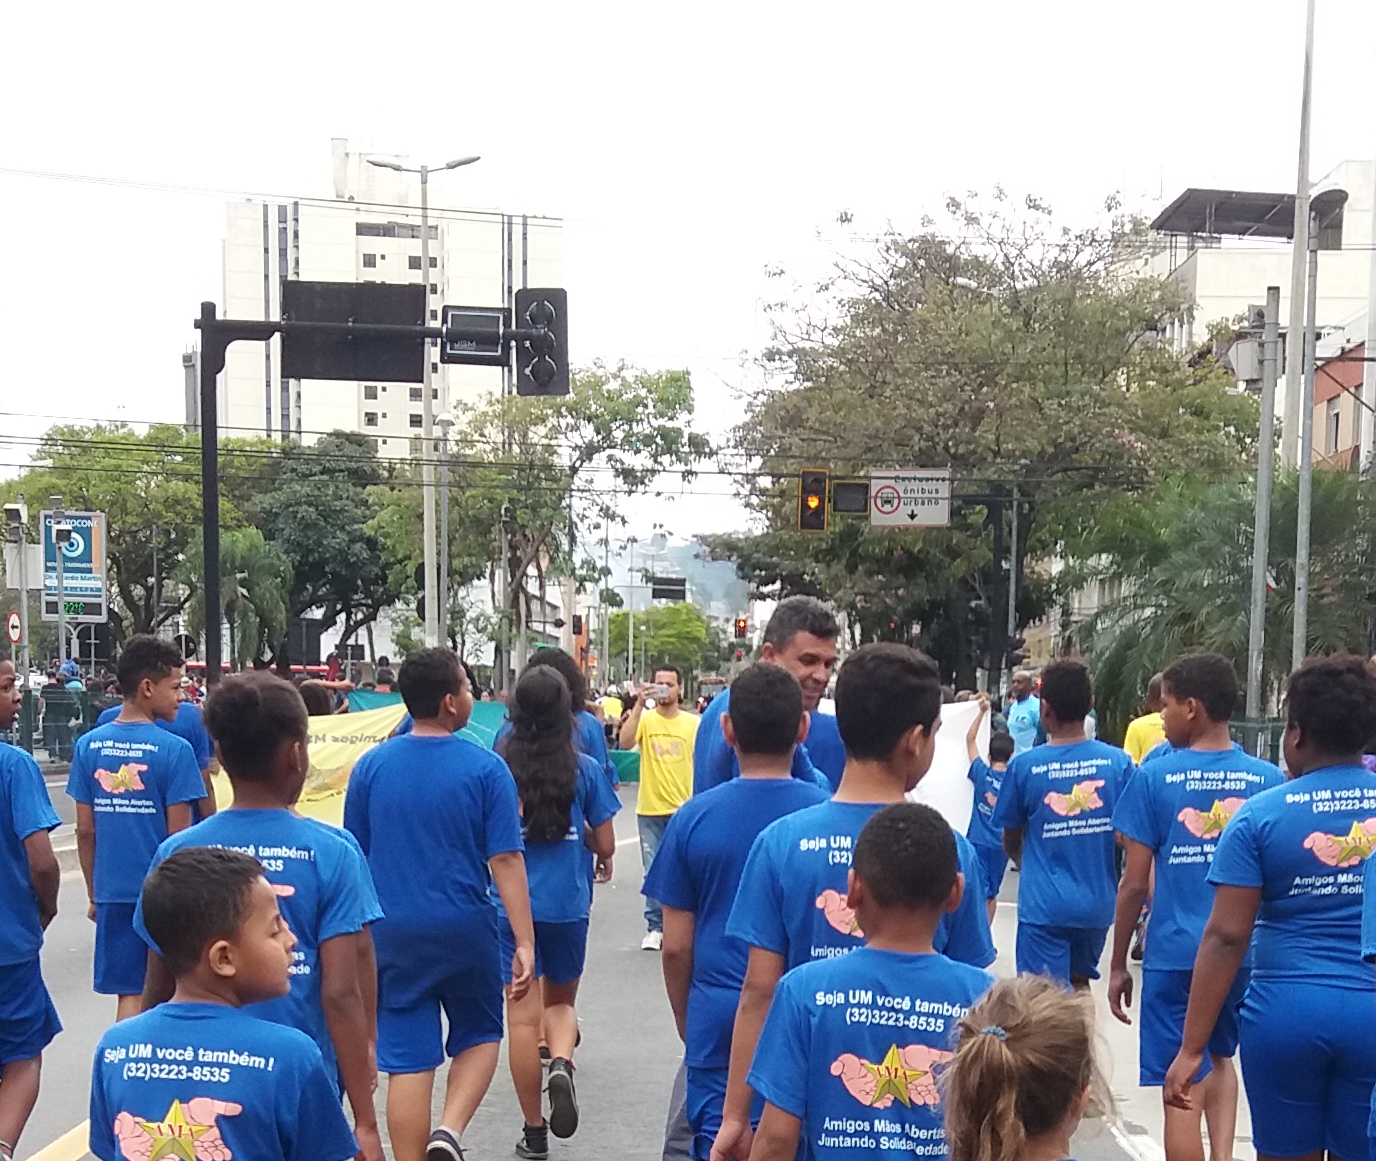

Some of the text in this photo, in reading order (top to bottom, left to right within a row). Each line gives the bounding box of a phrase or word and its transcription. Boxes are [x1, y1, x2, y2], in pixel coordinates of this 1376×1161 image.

[903, 487, 940, 495] ônibus
[903, 498, 940, 506] urbano
[1187, 770, 1201, 779] UM
[1203, 770, 1224, 779] você
[1227, 771, 1260, 783] também
[1312, 790, 1331, 800] UM
[1334, 787, 1361, 798] você
[799, 835, 851, 851] Seja UM
[259, 845, 308, 861] também
[1293, 874, 1334, 886] Amigos
[815, 990, 845, 1008] Seja
[848, 988, 873, 1006] UM
[876, 994, 911, 1011] você
[845, 1007, 945, 1033] (32)3223-8535
[128, 1043, 152, 1059] UM
[156, 1046, 194, 1062] você
[198, 1047, 265, 1068] também
[123, 1062, 230, 1083] (32)3223-8535
[823, 1116, 947, 1141] Amigos Mãos Abertas
[817, 1132, 876, 1150] Juntando
